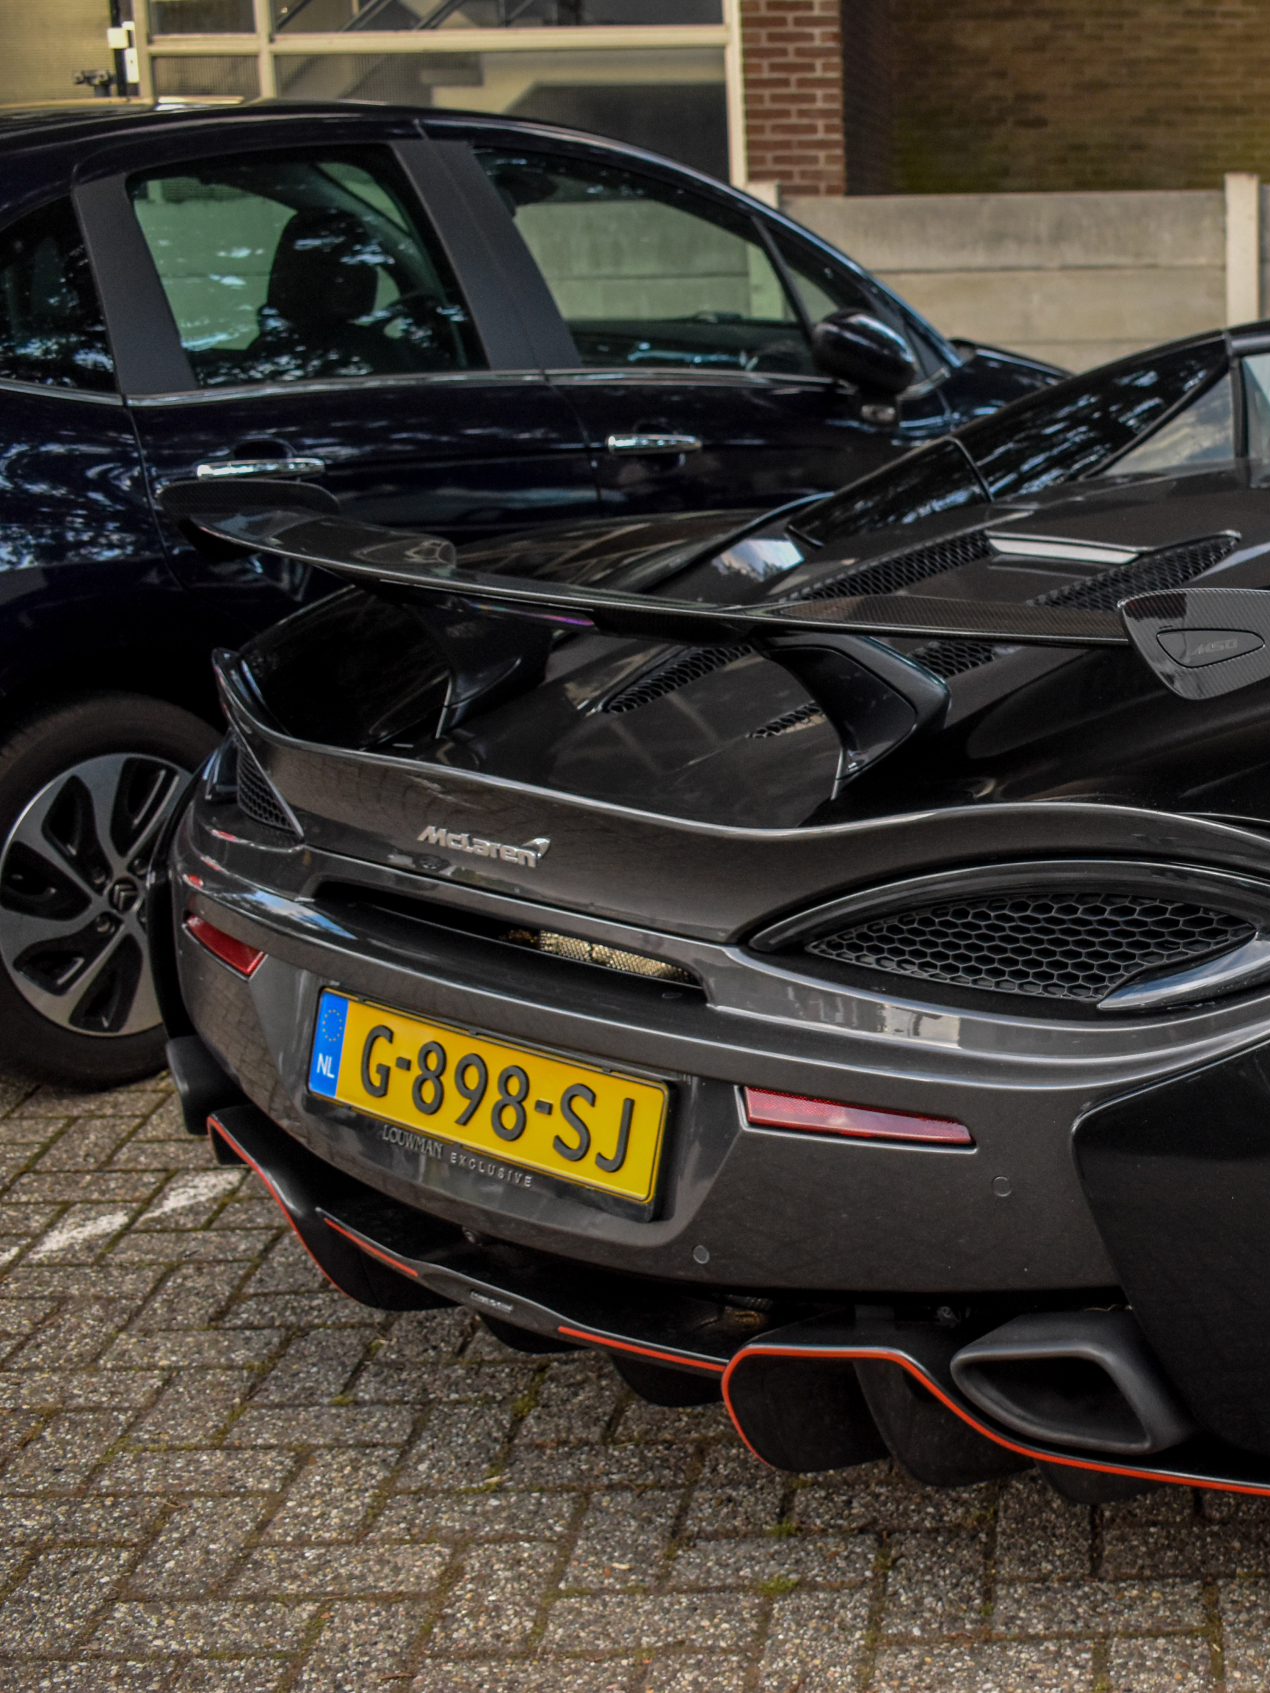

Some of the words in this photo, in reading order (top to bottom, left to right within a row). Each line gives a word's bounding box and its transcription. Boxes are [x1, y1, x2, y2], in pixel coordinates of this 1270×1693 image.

[417, 825, 537, 868] McLaren
[316, 1052, 335, 1079] NL
[360, 1024, 635, 1173] G-898-SJ
[382, 1124, 444, 1159] LOUWMAN
[450, 1151, 533, 1187] EXCLUSIVE
